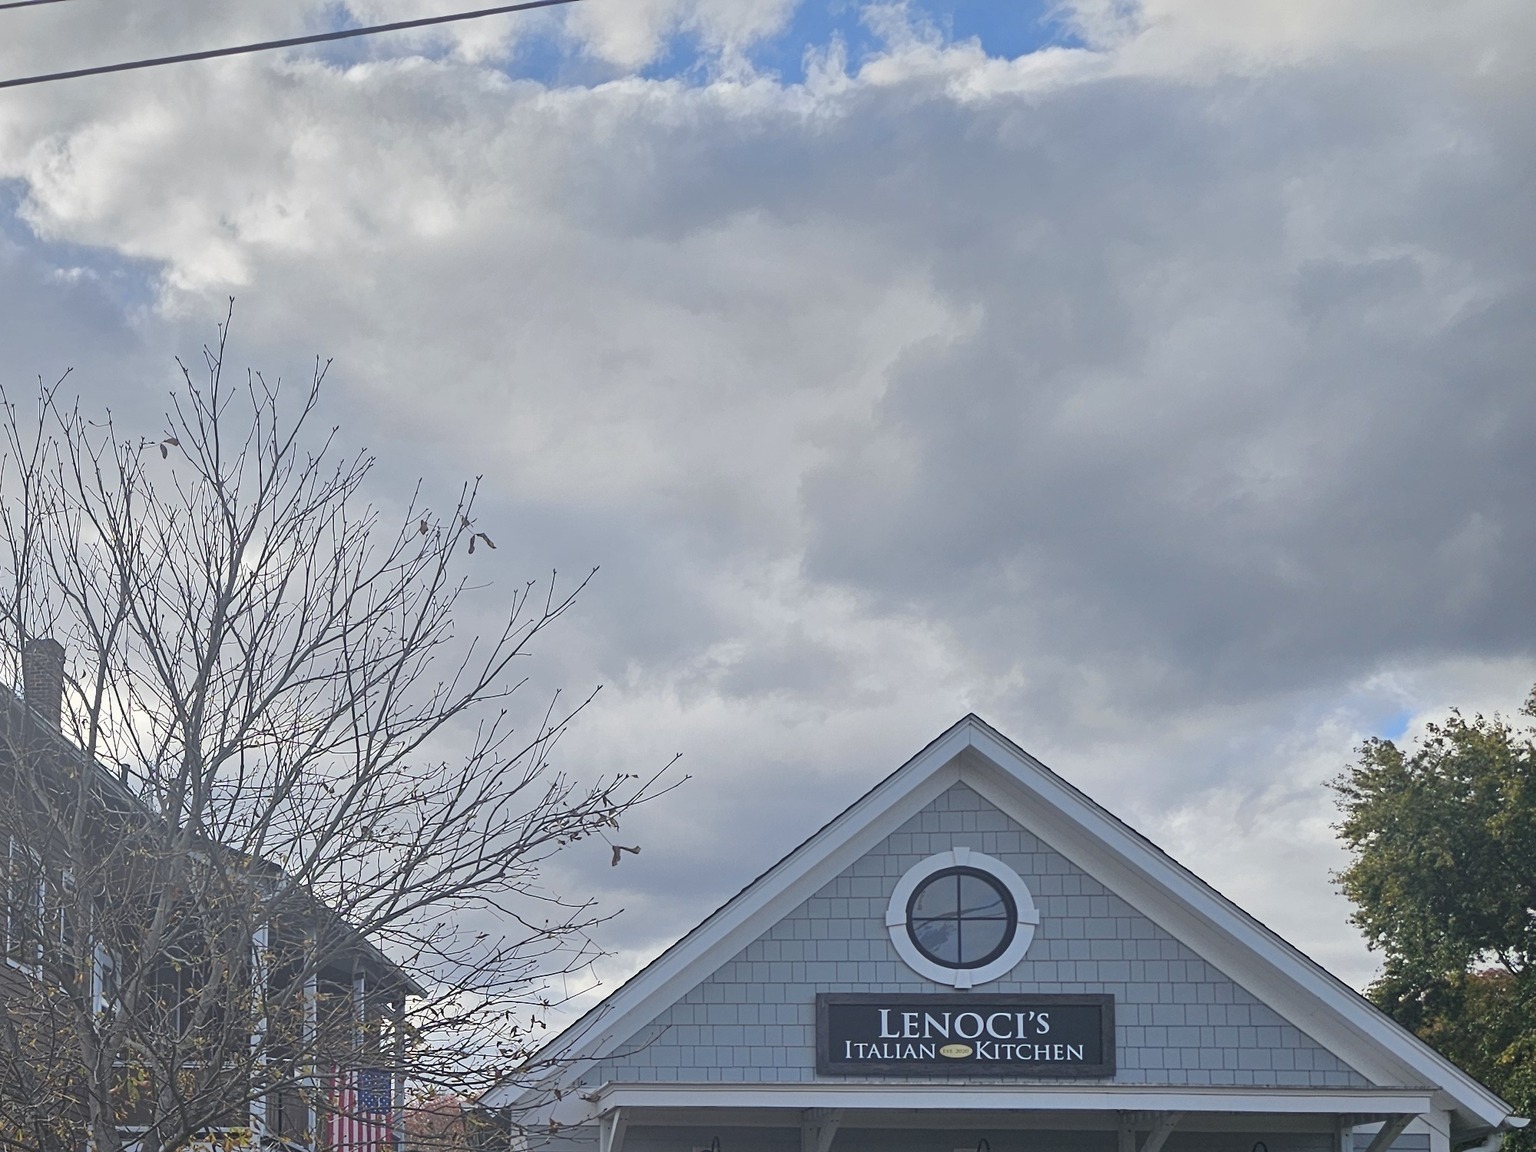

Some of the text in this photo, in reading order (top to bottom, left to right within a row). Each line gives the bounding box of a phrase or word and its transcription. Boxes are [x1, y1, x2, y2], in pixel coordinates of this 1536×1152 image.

[877, 1009, 1051, 1039] LENOCI'S
[845, 1040, 1084, 1061] ITALIAN KITCHEN
